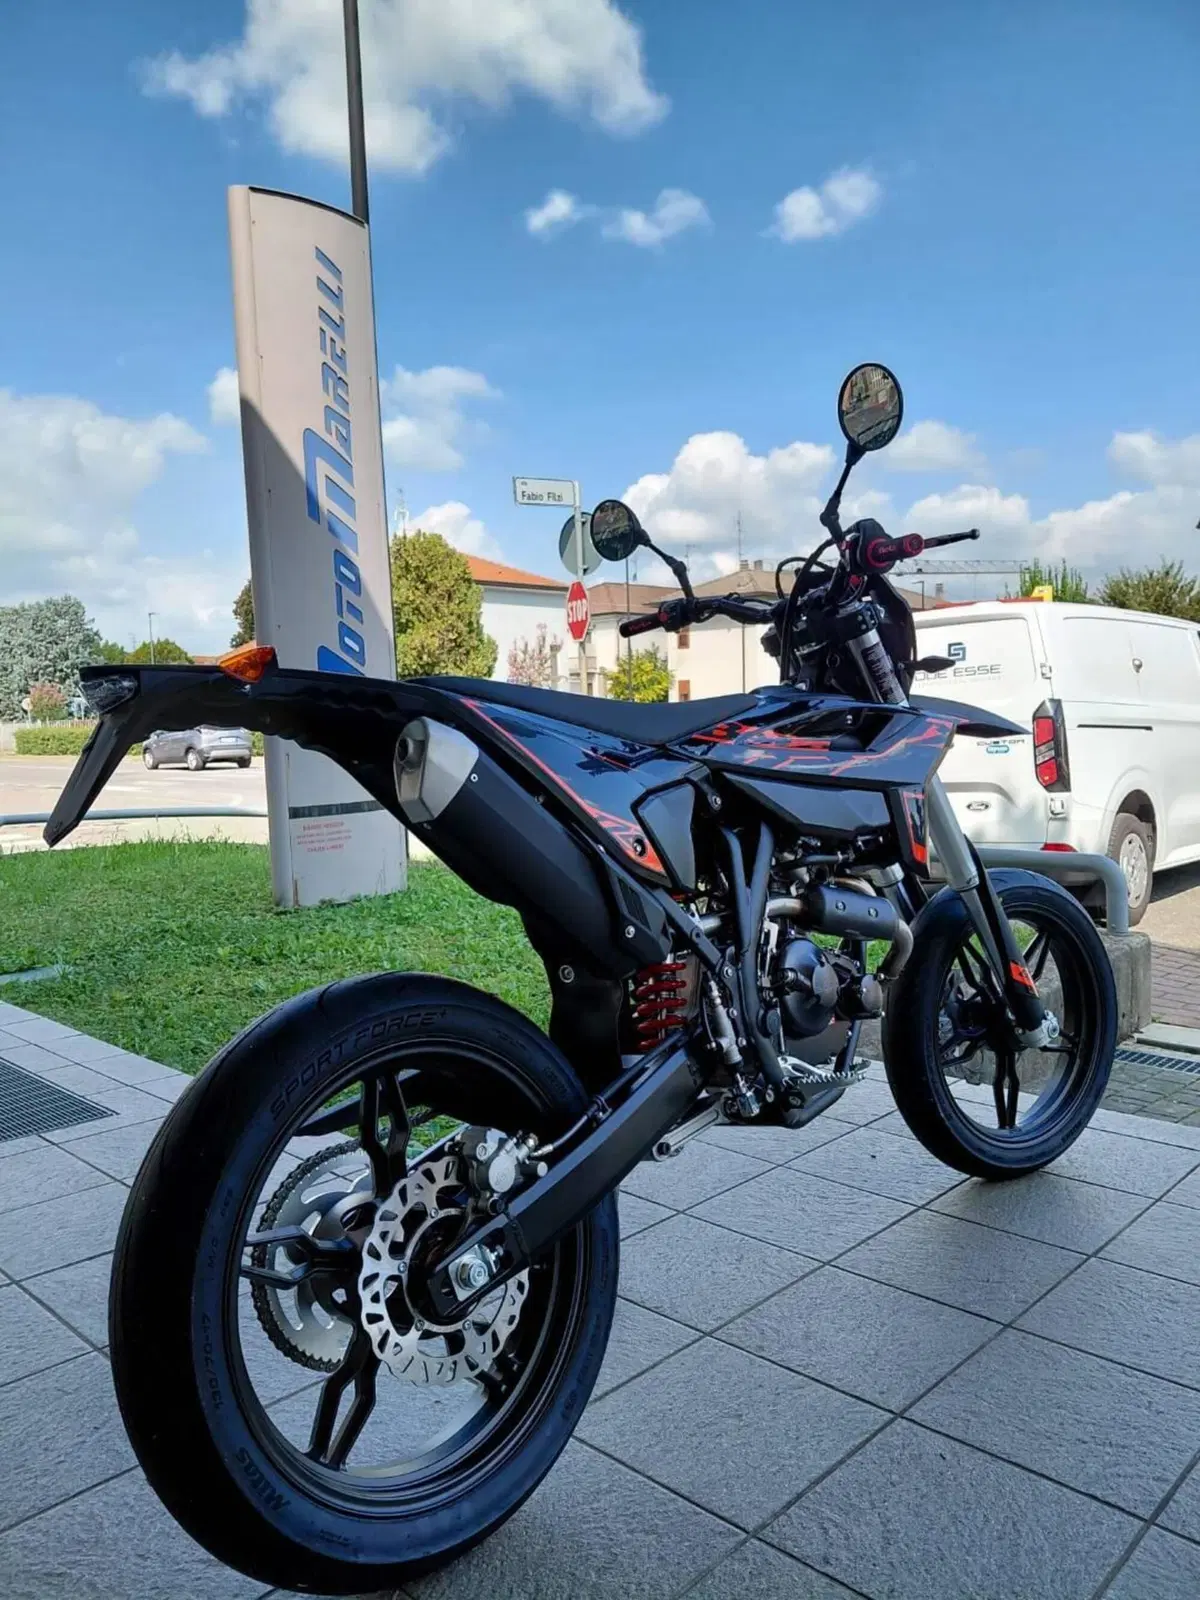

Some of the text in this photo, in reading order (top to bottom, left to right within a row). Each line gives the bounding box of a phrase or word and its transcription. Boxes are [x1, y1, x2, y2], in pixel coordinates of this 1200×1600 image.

[521, 490, 544, 502] Fabio
[567, 598, 588, 623] STOP
[953, 663, 1002, 678] ESSE
[270, 1037, 349, 1121] SPORT
[235, 1446, 292, 1511] Mitas
